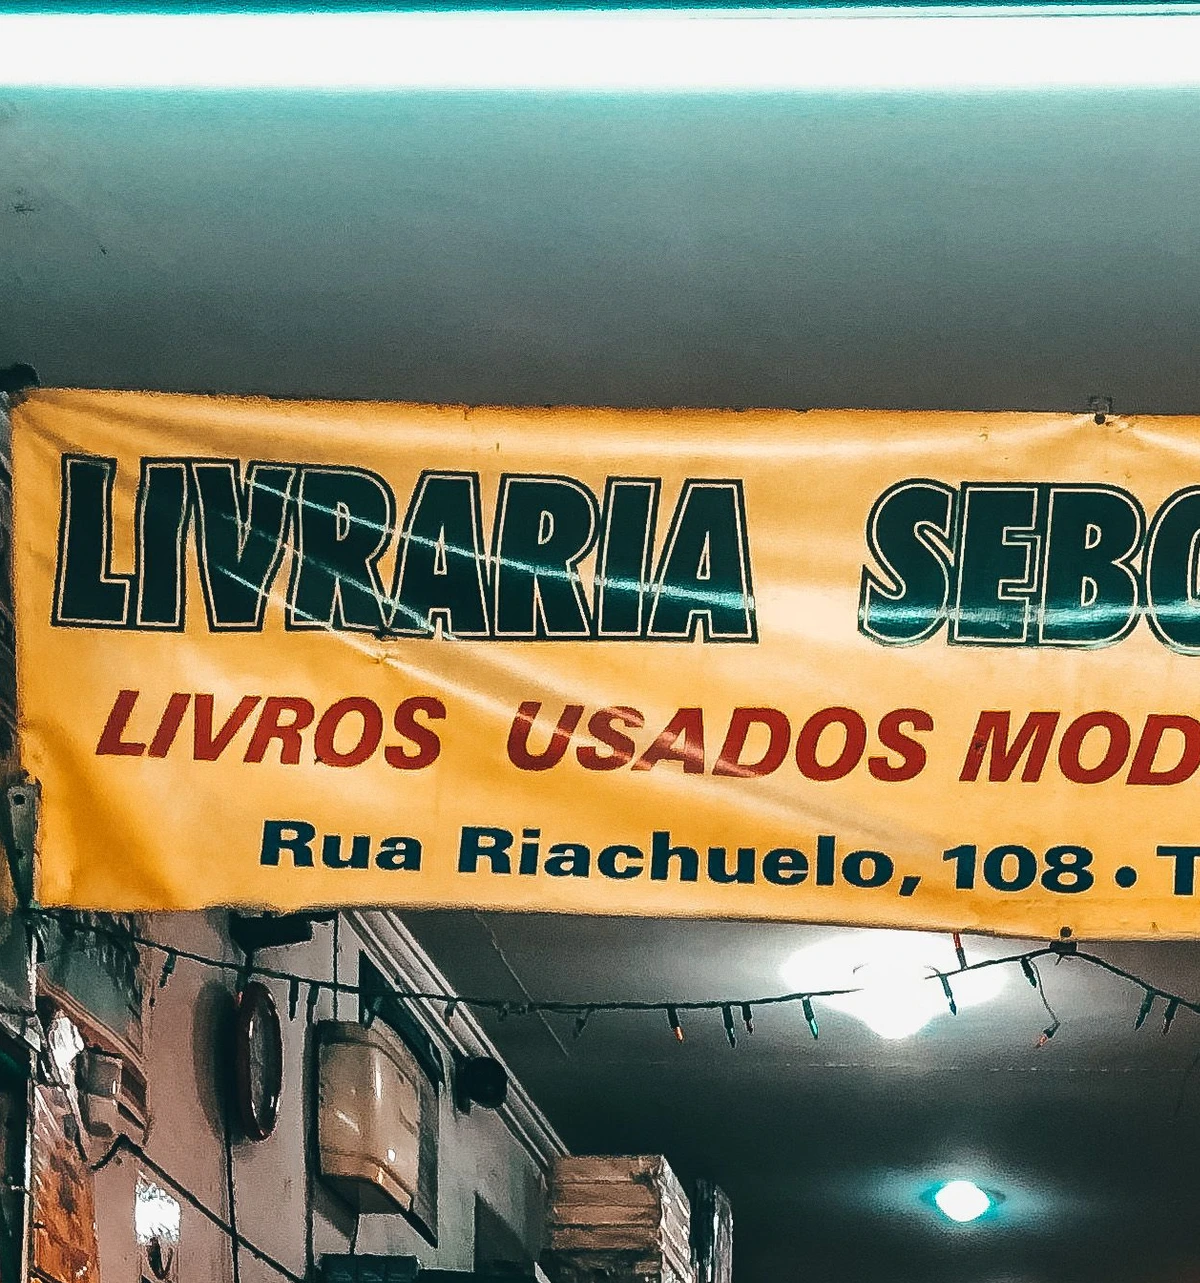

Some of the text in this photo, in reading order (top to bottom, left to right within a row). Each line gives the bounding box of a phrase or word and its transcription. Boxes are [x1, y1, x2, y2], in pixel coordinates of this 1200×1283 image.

[51, 453, 758, 643] LIVRARIA
[96, 689, 447, 770] LIVROS
[507, 701, 934, 783] USADOS
[260, 820, 422, 872] Rua
[456, 826, 924, 898] Riachuelo,
[942, 844, 1095, 895] 108
